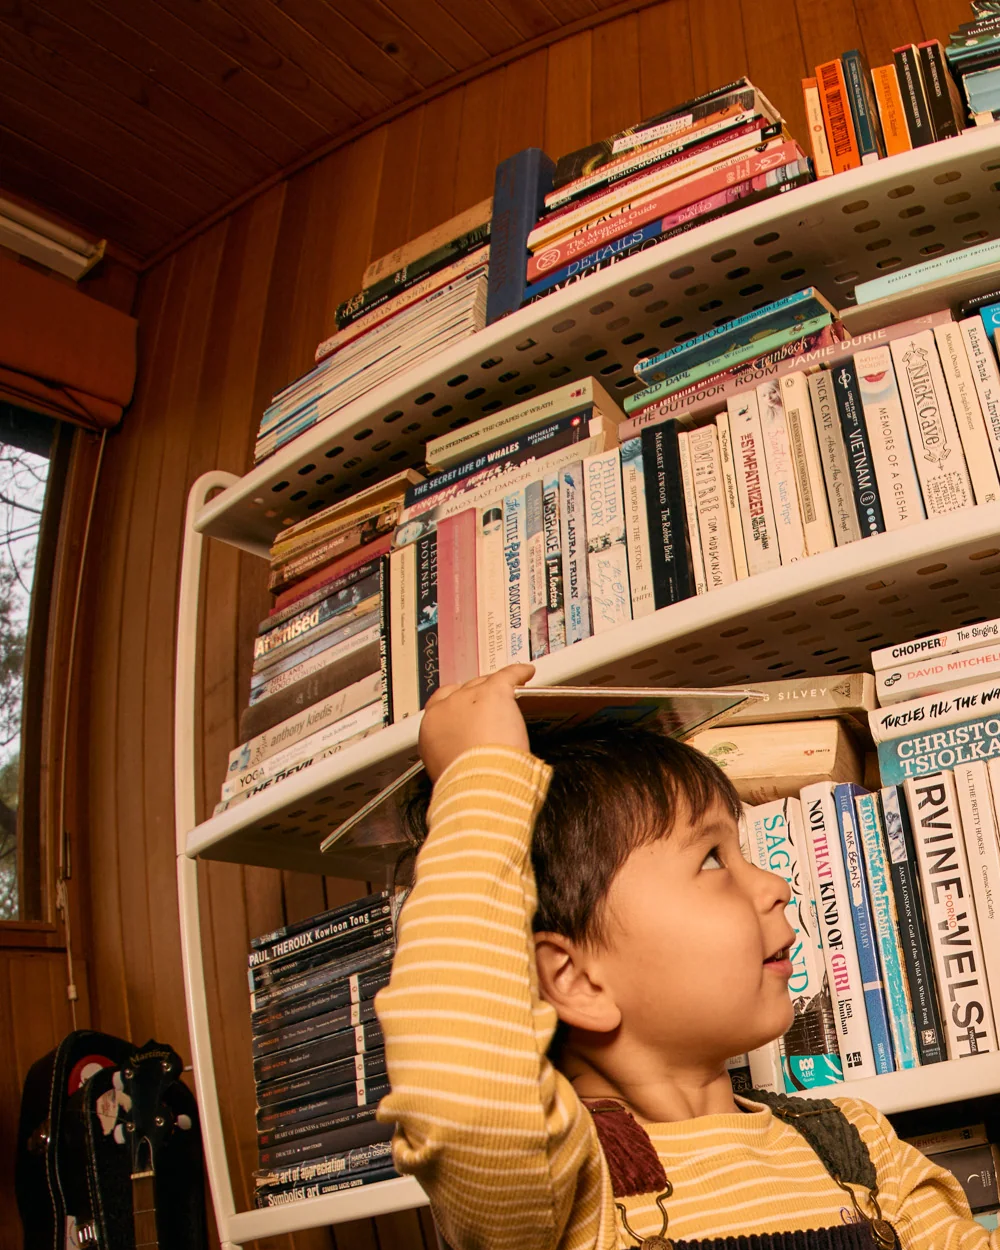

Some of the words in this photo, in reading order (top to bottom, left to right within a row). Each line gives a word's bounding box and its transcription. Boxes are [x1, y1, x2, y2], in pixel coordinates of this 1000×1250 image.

[567, 237, 585, 249] The
[588, 219, 627, 240] Monocle
[629, 203, 657, 218] Guide
[567, 229, 644, 276] DETAILS
[788, 345, 835, 368] JAMIE
[841, 330, 887, 350] DURIE
[967, 328, 984, 362] Richard
[976, 360, 989, 382] Panek
[631, 411, 655, 427] THE
[660, 384, 725, 415] OUTDOOR
[735, 364, 779, 387] ROOM
[633, 384, 662, 401] ROALD
[666, 372, 690, 388] DAHL
[528, 424, 560, 442] MICHELINE
[531, 432, 554, 445] JENNER
[414, 485, 428, 496] THE
[430, 470, 456, 489] SECRET
[458, 464, 475, 477] LIFE
[476, 457, 486, 467] OF
[487, 442, 519, 462] WHALES
[741, 439, 764, 518] SYMPATHIZER
[850, 429, 871, 489] VIETNAM
[879, 408, 895, 450] MEMOIRS
[888, 454, 898, 468] OF
[894, 483, 907, 521] GEISHA
[589, 461, 603, 527] GREGORY
[602, 457, 617, 524] PHILIPPA
[568, 518, 577, 558] LAURA
[421, 541, 429, 599] DOWNER
[569, 560, 578, 599] FRIDAY
[956, 629, 970, 642] The
[972, 622, 998, 639] Singing
[907, 665, 944, 680] DAVID
[270, 721, 306, 747] anthony
[307, 704, 333, 727] kiedis
[881, 707, 925, 730] TURTLES
[929, 703, 952, 718] ALL
[953, 695, 977, 712] THE
[808, 800, 827, 837] NOT
[846, 831, 854, 848] MR
[913, 773, 963, 904] IRVINE
[813, 836, 833, 878] THAT
[820, 881, 840, 927] KIND
[944, 894, 957, 930] PORNO
[249, 951, 270, 966] PAUL
[272, 932, 313, 958] THEROUX
[315, 921, 348, 940] Kowloon
[349, 914, 369, 927] Tong
[828, 928, 844, 951] OF
[831, 951, 849, 997] GIRL
